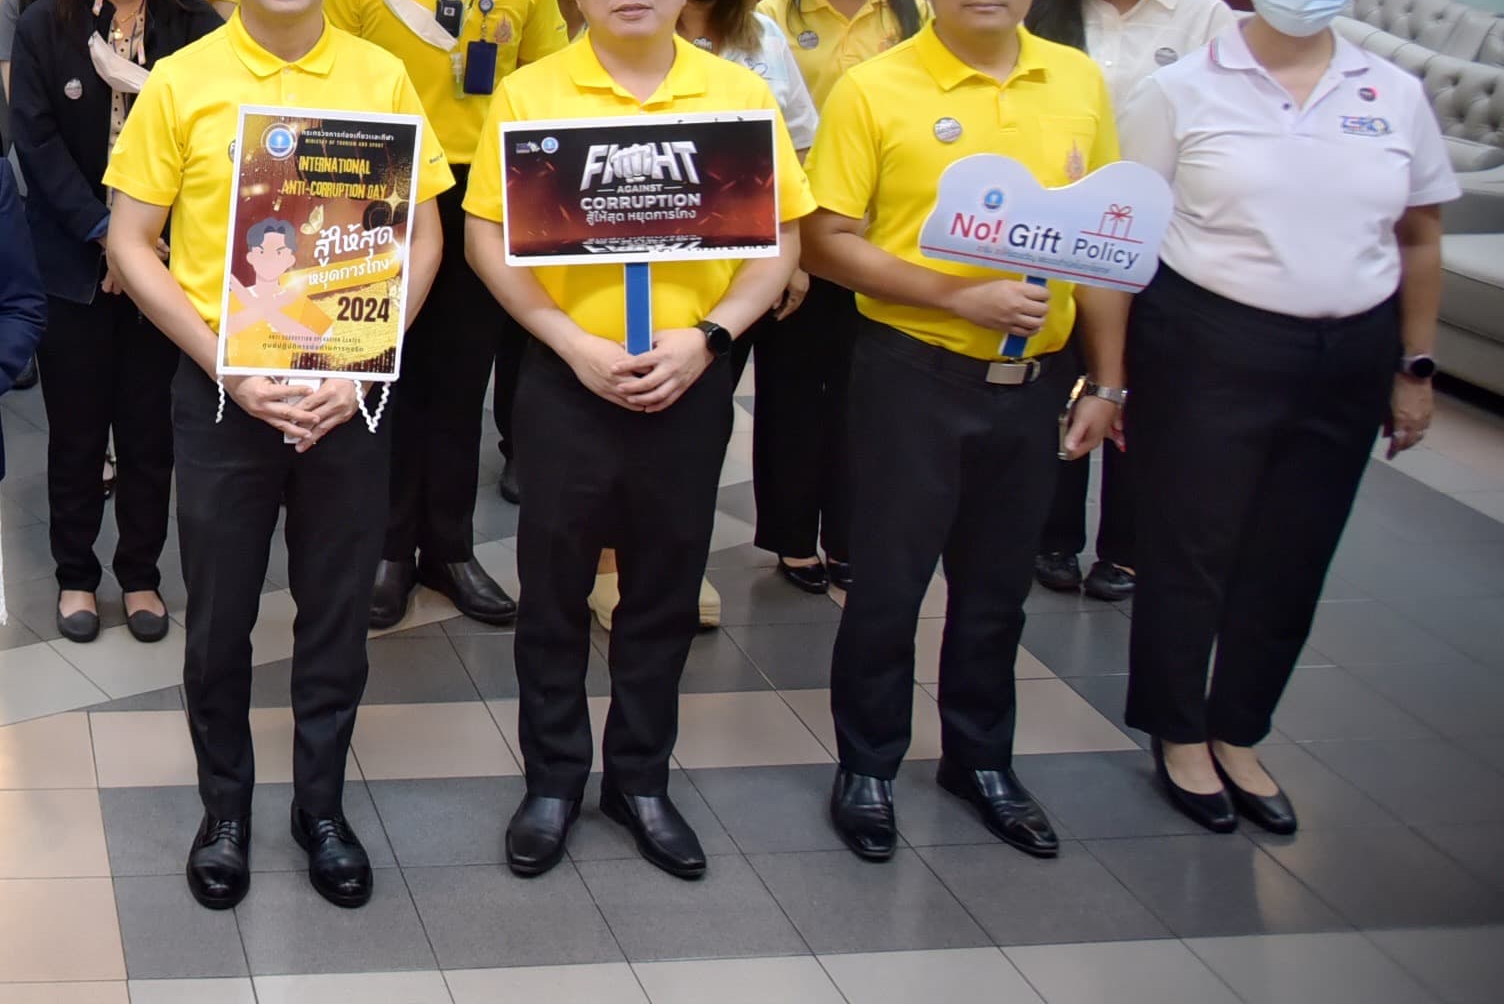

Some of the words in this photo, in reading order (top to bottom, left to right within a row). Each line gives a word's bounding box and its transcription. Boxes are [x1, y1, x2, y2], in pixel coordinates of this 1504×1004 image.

[298, 154, 371, 175] INTERNATIONAL
[280, 179, 366, 199] ANTI-CORRUPTION
[367, 183, 388, 200] DAY
[616, 183, 663, 194] AGAINST
[580, 193, 701, 211] CORRUPTION
[585, 209, 625, 227] สู้ให้สุด
[627, 209, 697, 224] หยุดการโกง
[313, 223, 394, 267] สู้ให้สุด
[950, 212, 1004, 244] No!
[1008, 223, 1062, 254] Gift
[1072, 237, 1140, 270] Policy
[307, 255, 390, 290] หยุดการโกง
[336, 296, 391, 322] 2024
